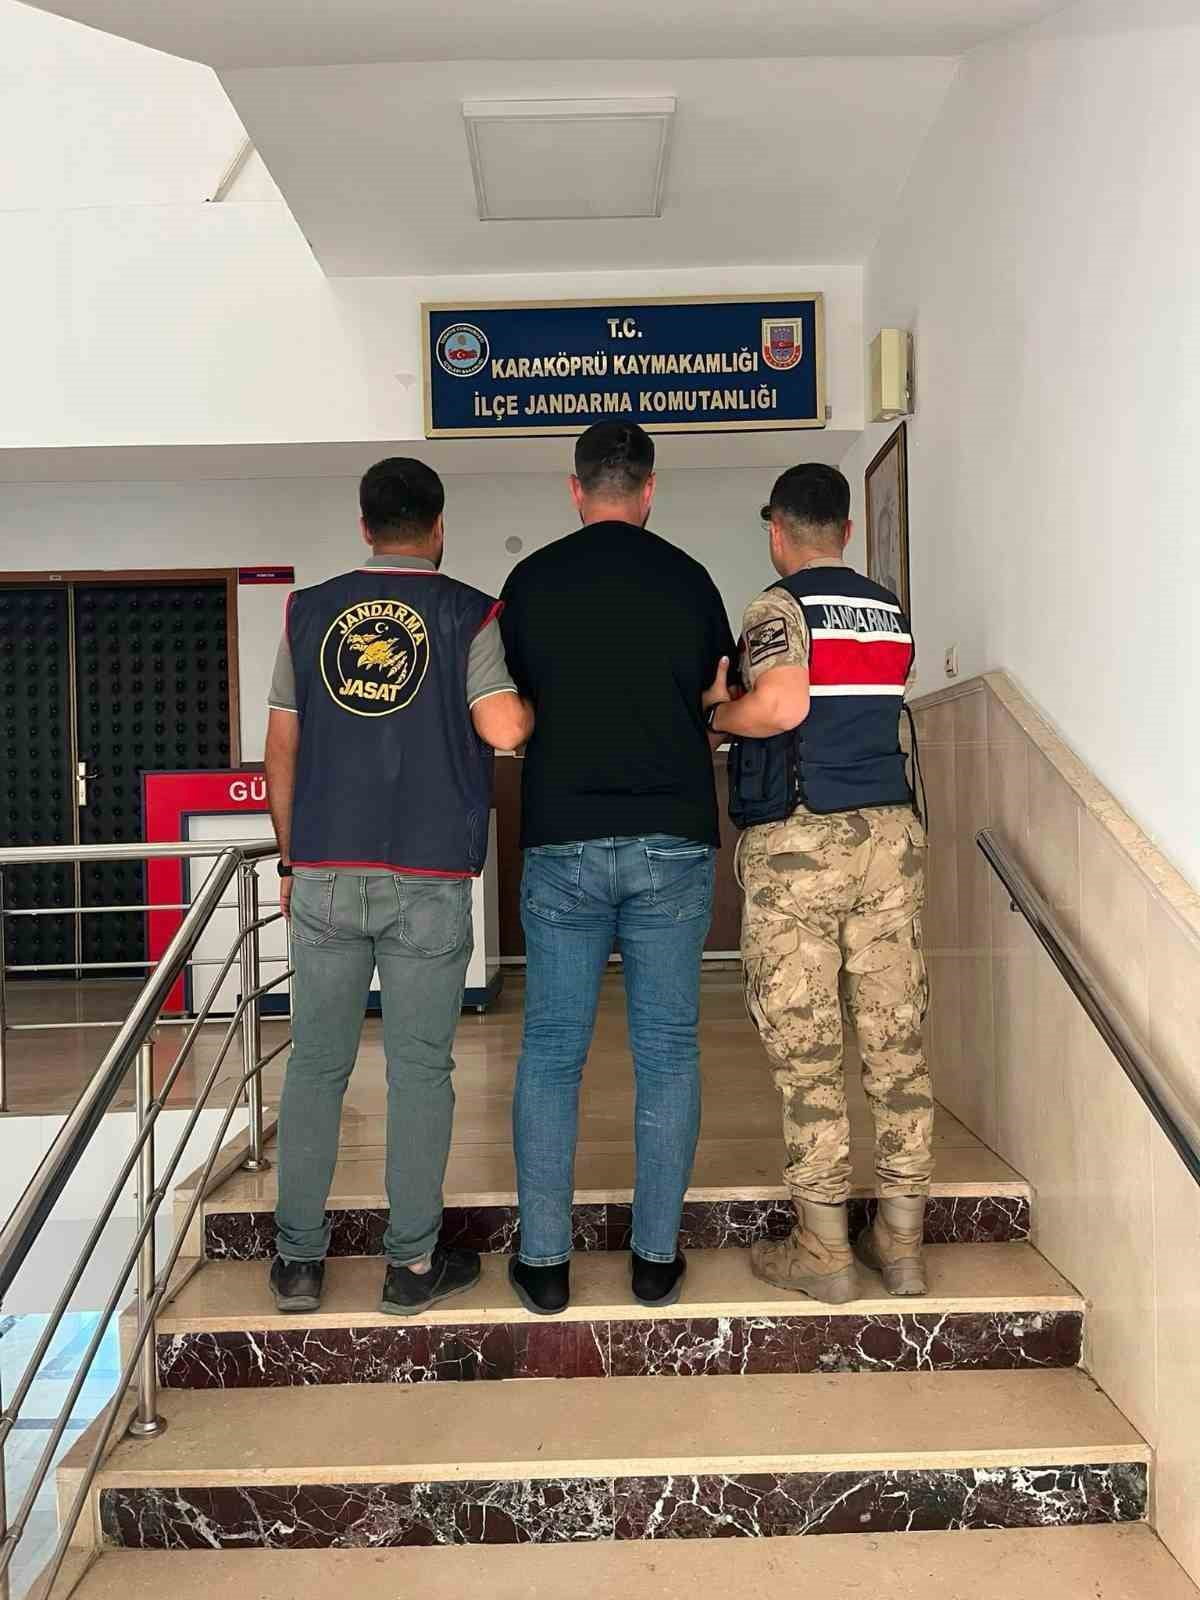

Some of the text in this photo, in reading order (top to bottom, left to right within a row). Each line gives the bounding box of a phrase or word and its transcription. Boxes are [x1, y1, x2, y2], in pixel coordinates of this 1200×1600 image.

[607, 318, 643, 339] T.C.
[491, 350, 608, 379] KARAKÖPRÜ
[613, 346, 759, 375] KAYMAKAMLIĞI
[474, 384, 777, 421] İLÇE JANDARMA KOMUTANLIĞI
[338, 604, 425, 647] JANDARMA
[822, 604, 903, 634] JANDARMA
[338, 678, 400, 702] JASAT
[229, 776, 267, 802] GÜ
